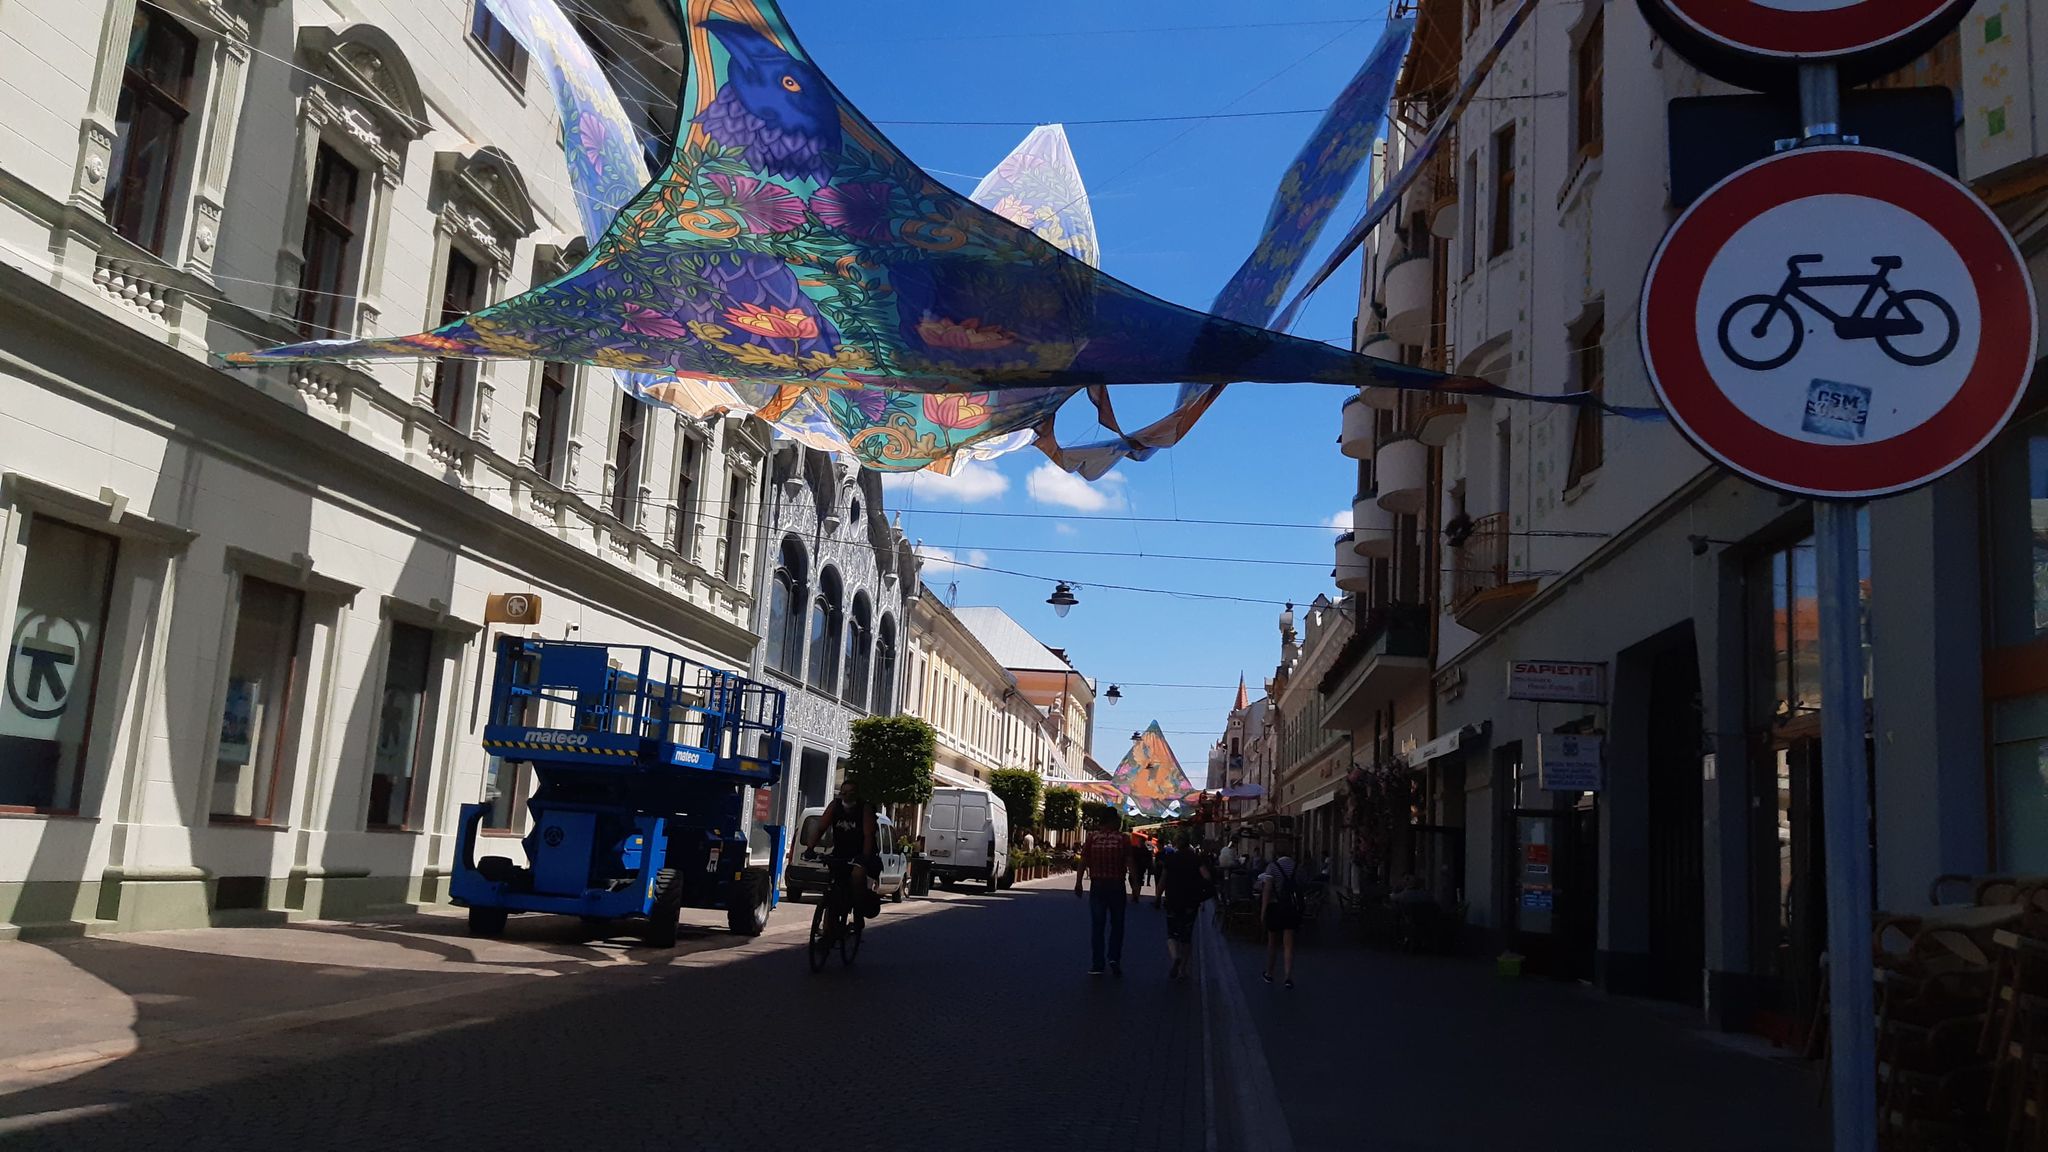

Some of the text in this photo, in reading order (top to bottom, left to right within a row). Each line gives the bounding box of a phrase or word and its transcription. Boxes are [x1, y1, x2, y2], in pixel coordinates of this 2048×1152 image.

[1514, 663, 1594, 676] SAPIENT
[524, 730, 588, 745] mateco
[674, 750, 700, 764] mateco
